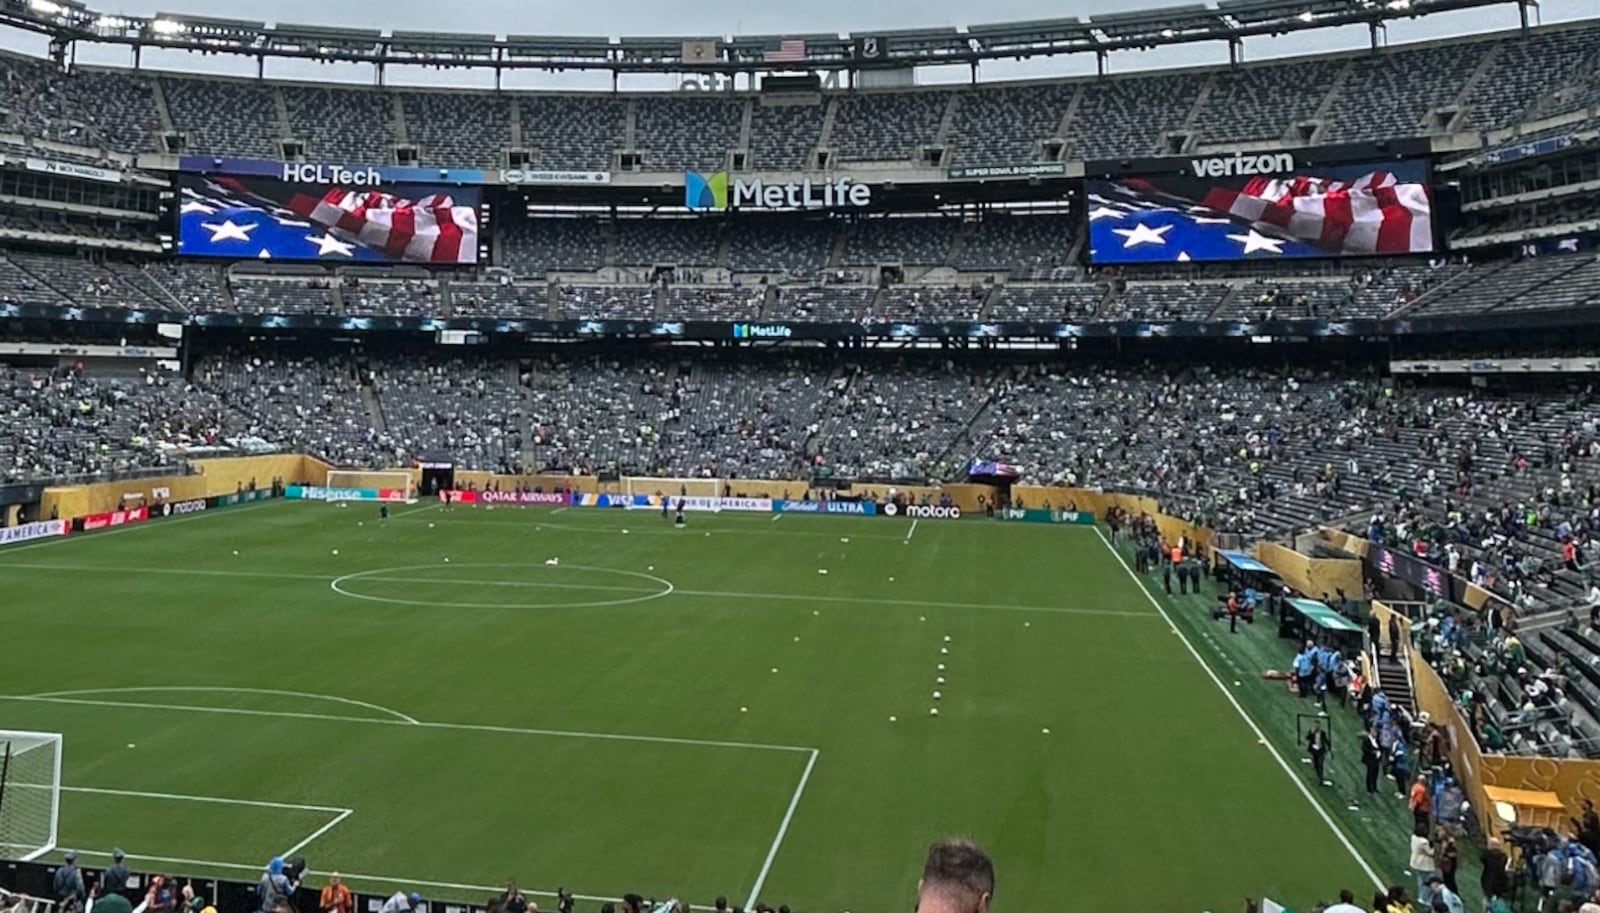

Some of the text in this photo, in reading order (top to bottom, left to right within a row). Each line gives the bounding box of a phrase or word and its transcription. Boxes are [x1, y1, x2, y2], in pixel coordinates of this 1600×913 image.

[1192, 152, 1294, 177] verizon
[283, 163, 381, 186] HCLTech
[733, 177, 871, 207] MetLife
[750, 325, 792, 337] MetLife
[301, 485, 362, 499] Hisense
[482, 491, 563, 503] QATAR AIRWAYS
[607, 494, 635, 505] VISA
[827, 502, 865, 513] ULTRA
[1009, 510, 1026, 519] PIF
[1062, 512, 1079, 521] PIF
[6, 523, 49, 540] AMERICA
